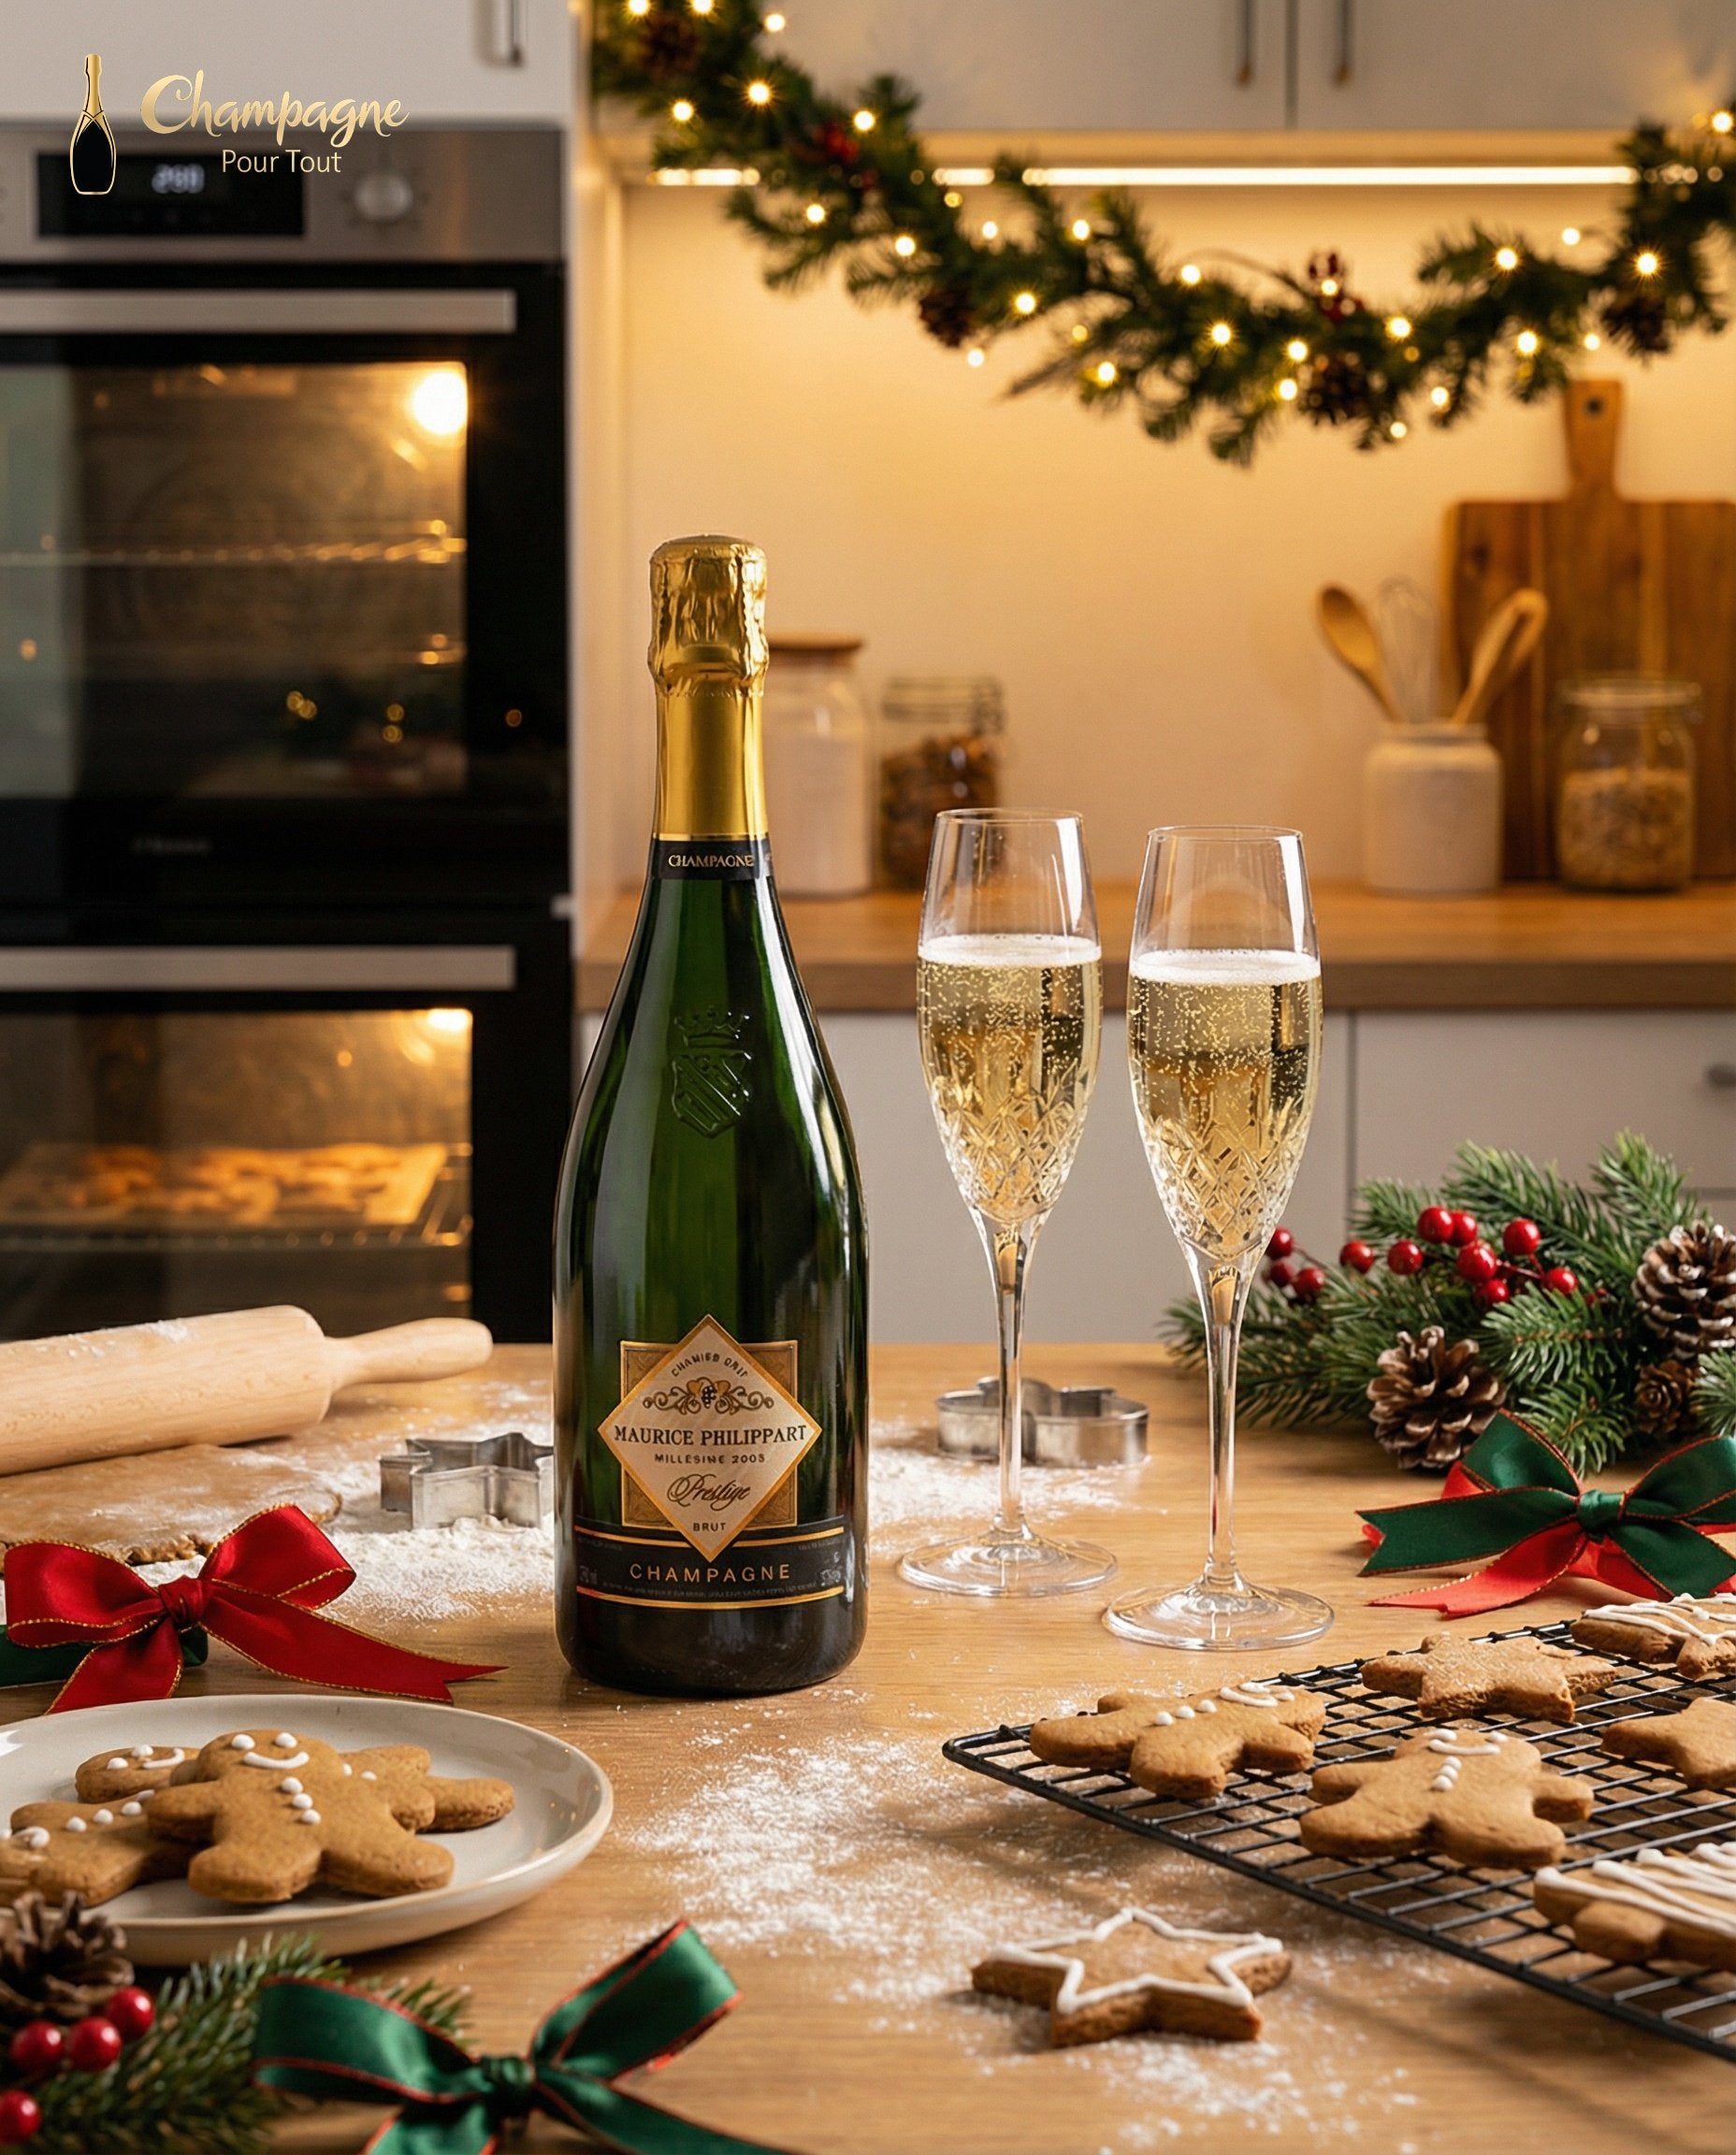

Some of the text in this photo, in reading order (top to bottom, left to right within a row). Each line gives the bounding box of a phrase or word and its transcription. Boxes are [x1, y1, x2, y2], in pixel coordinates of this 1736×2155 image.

[614, 1425, 807, 1446] MAURICE PHILIPPART
[666, 1473, 752, 1512] Prestige
[692, 1523, 727, 1532] BRUT
[629, 1563, 791, 1584] CHAMPAGNE
